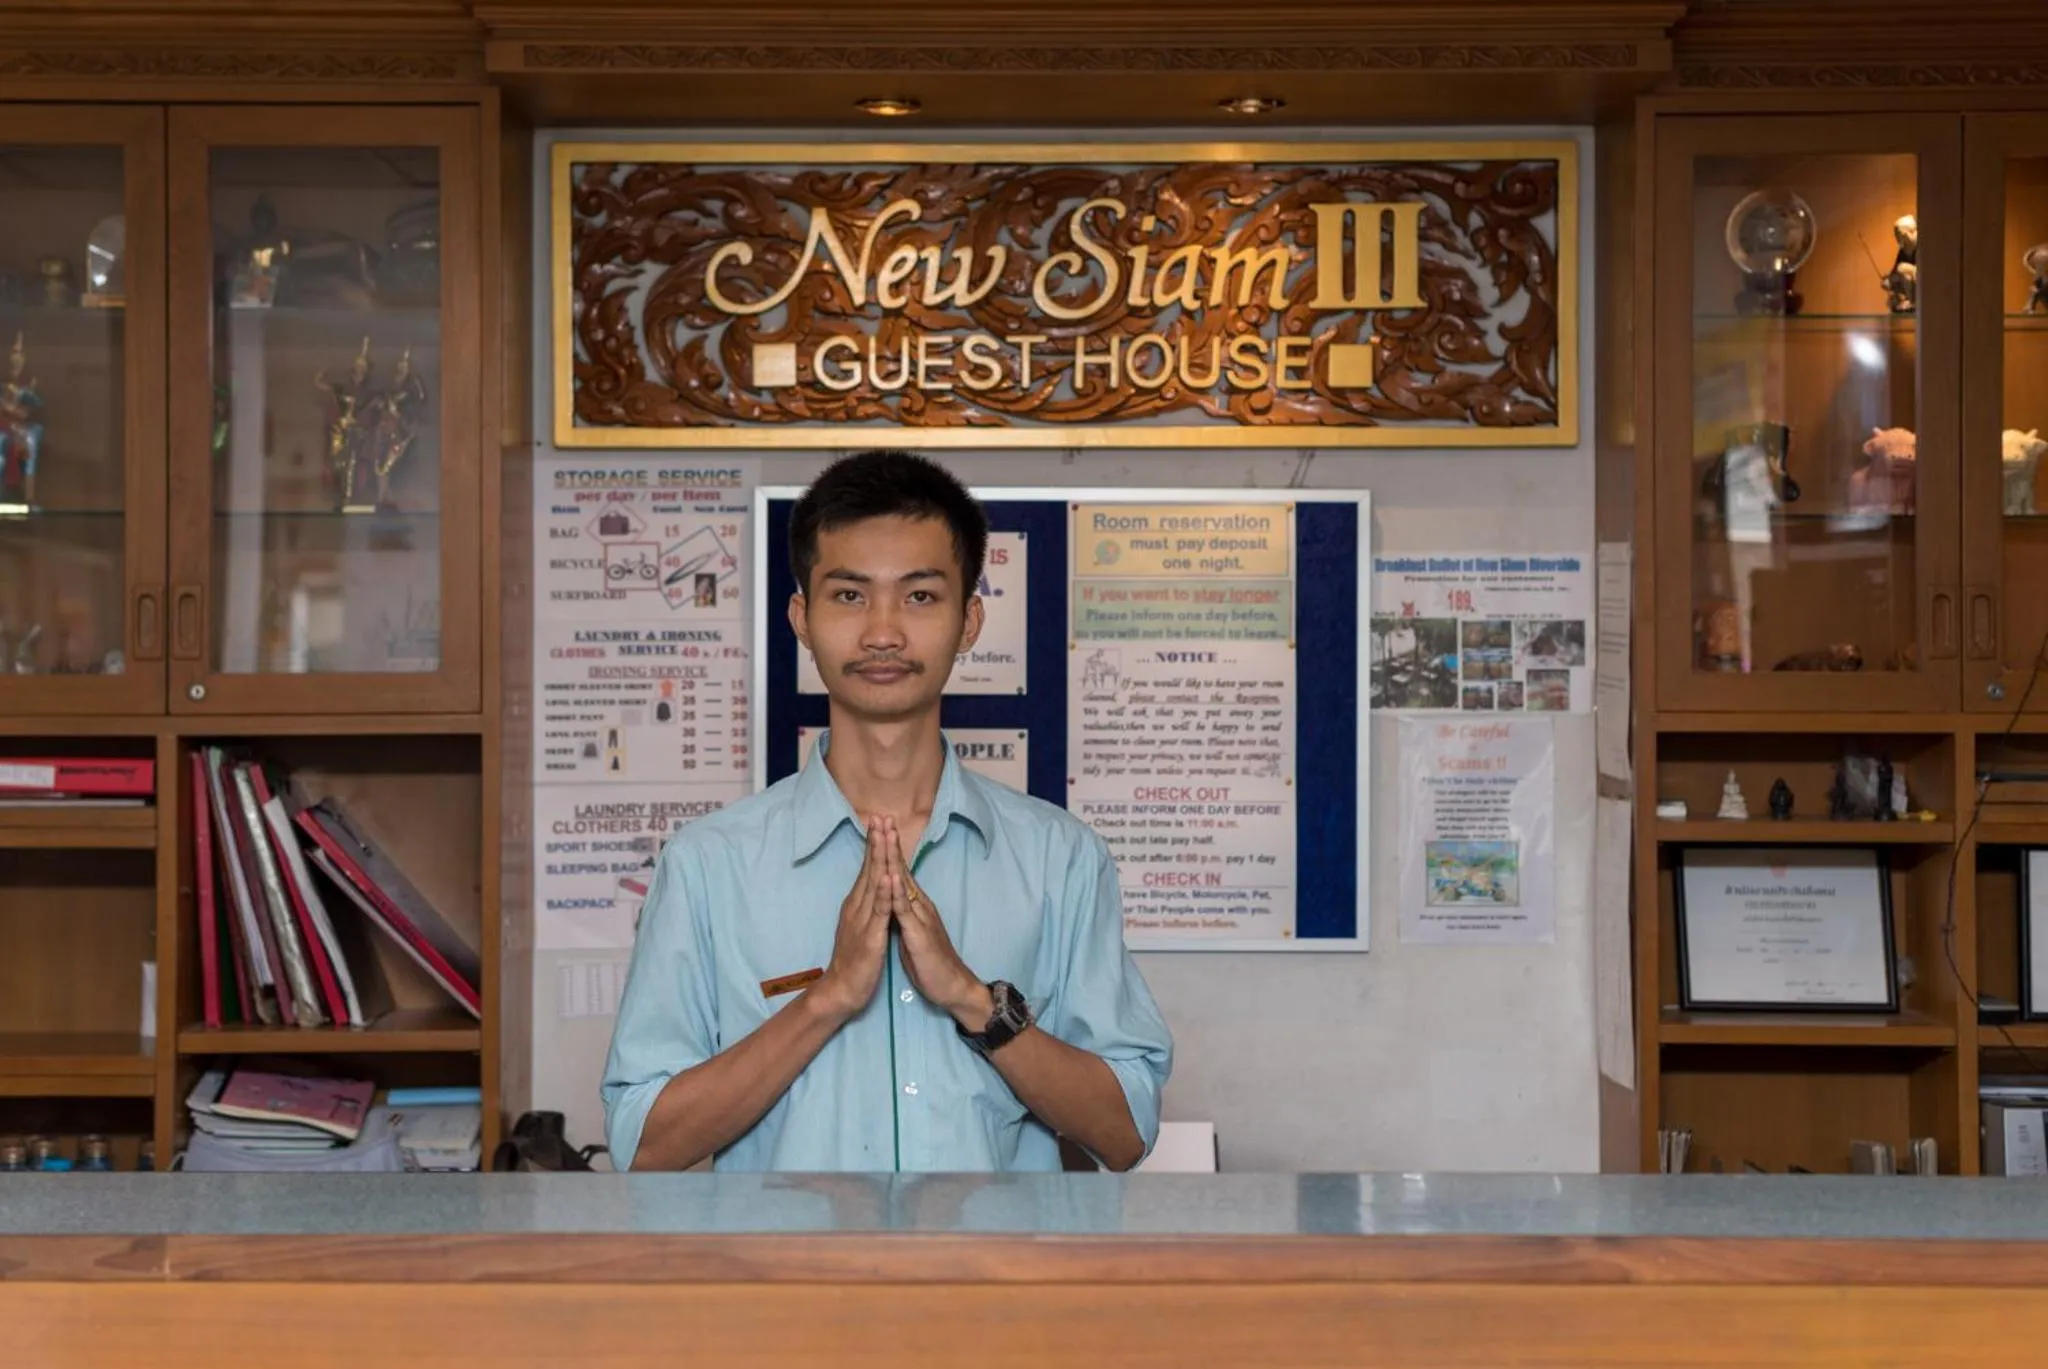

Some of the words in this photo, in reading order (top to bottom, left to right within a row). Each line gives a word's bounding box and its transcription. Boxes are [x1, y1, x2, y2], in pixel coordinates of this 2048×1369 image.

[704, 200, 1008, 317] New
[1032, 198, 1292, 321] Siam
[1308, 201, 1428, 310] III
[813, 334, 1048, 392] GUEST
[1073, 334, 1313, 392] HOUSE
[554, 470, 648, 487] STORAGE
[658, 469, 742, 486] SERVICE
[574, 490, 601, 502] per
[606, 490, 637, 502] day
[651, 490, 678, 502] per
[1093, 513, 1148, 528] Room
[1160, 513, 1270, 530] reservation
[550, 527, 579, 538] BAG
[665, 525, 679, 538] 15
[721, 525, 737, 537] 20
[1130, 538, 1168, 550] must
[1177, 539, 1205, 552] pay
[1209, 537, 1267, 552] deposit
[990, 548, 1008, 564] IS
[550, 559, 605, 569] BICYCLE
[664, 557, 680, 567] 40
[1163, 560, 1191, 569] one
[1200, 557, 1244, 571] night.
[551, 590, 626, 600] SURFBOARD
[722, 588, 739, 598] 60
[1082, 587, 1094, 599] If
[1100, 590, 1127, 602] you
[1131, 589, 1168, 599] want
[1174, 589, 1189, 599] to
[1193, 589, 1224, 602] stay
[1229, 589, 1278, 602] longer
[1086, 609, 1127, 621] Please
[1131, 609, 1173, 620] inform
[1178, 611, 1201, 621] one
[1206, 610, 1229, 622] day
[575, 631, 639, 642] LAUNDRY
[661, 631, 722, 642] IRONING
[1093, 630, 1114, 640] you
[1118, 628, 1138, 639] will
[1143, 629, 1162, 639] not
[1166, 628, 1181, 639] be
[1184, 628, 1225, 639] forced
[1229, 629, 1241, 639] to
[618, 645, 678, 656] SERVICE
[681, 647, 699, 658] 40
[1155, 652, 1217, 663] NOTICE
[972, 652, 1016, 664] before.
[589, 666, 647, 678] IRONING
[650, 666, 708, 678] SERVICE
[681, 680, 695, 690] 20
[1134, 787, 1192, 801] CHECK
[1197, 787, 1231, 800] OUT
[575, 804, 646, 819] LAUNDRY
[1083, 805, 1128, 815] PLEASE
[1131, 805, 1177, 814] INFORM
[1180, 805, 1202, 814] ONE
[1208, 805, 1231, 815] DAY
[1234, 805, 1281, 815] BEFORE
[553, 820, 642, 834] CLOTHERS
[647, 818, 667, 831] 40
[1094, 818, 1126, 828] Check
[1130, 819, 1146, 828] out
[1150, 818, 1172, 828] time
[1175, 818, 1184, 828] is
[1130, 836, 1146, 845] out
[1150, 836, 1168, 845] late
[1171, 837, 1189, 846] pay
[546, 843, 586, 853] SPORT
[1130, 854, 1146, 862] out
[1149, 854, 1173, 863] after
[1226, 854, 1245, 864] pay
[1257, 853, 1276, 865] day
[546, 863, 608, 875] SLEEPING
[611, 863, 639, 873] BAG
[1143, 872, 1200, 885] CHECK
[1206, 873, 1222, 885] IN
[1124, 891, 1146, 899] have
[547, 899, 615, 910] BACKPACK
[1138, 905, 1158, 914] Thai
[1161, 905, 1194, 915] People
[1228, 905, 1248, 914] with
